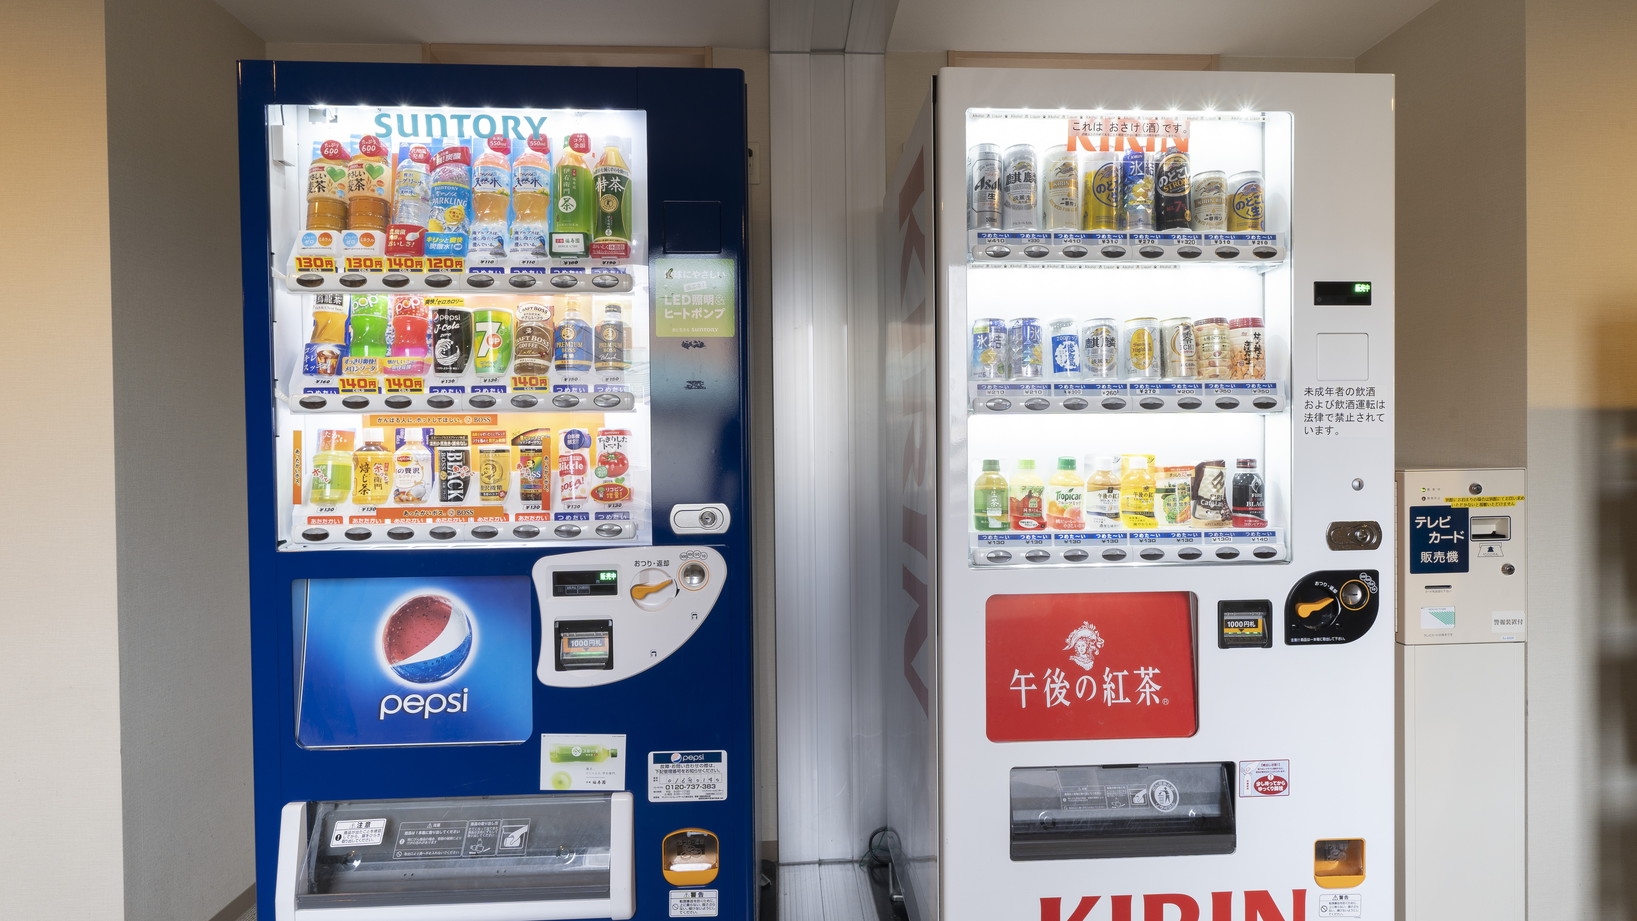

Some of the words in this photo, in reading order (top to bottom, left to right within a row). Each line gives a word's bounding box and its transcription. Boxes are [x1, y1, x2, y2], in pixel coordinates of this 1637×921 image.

[375, 112, 548, 140] SUNTORY
[1072, 122, 1102, 132] これは
[1109, 122, 1187, 133] おさけ(酒)です。
[1066, 118, 1189, 152] KIRIN
[596, 176, 625, 192] 特茶
[561, 197, 574, 211] 茶
[296, 257, 334, 268] 130円
[346, 257, 383, 268] 130円
[388, 257, 424, 268] 140円
[427, 257, 463, 268] 120円
[395, 297, 420, 315] pop
[440, 314, 460, 322] pepsi
[664, 307, 726, 319] ヒートポンプ
[476, 321, 502, 357] 7
[531, 335, 550, 346] BOSS
[340, 378, 377, 388] 140円
[386, 378, 422, 388] 140円
[512, 376, 547, 386] 140円
[1304, 386, 1376, 397] 未成年者の飲酒
[1304, 399, 1385, 410] および飲酒運転は
[1303, 412, 1384, 423] 法律で禁止されて
[1304, 425, 1340, 436] います。
[598, 435, 628, 443] すっきりした
[358, 462, 370, 495] 焙じ茶
[447, 452, 464, 500] BLACK
[990, 490, 999, 507] 生茶
[1414, 516, 1452, 529] テレビ
[1428, 531, 1464, 544] カード
[1420, 551, 1459, 563] 販売機
[600, 572, 617, 580] 販売中
[1314, 581, 1338, 594] おつり・返却
[1227, 620, 1256, 628] 1000円札
[1493, 618, 1523, 626] 警報装置付
[570, 639, 603, 647] 1000円札
[1010, 667, 1162, 709] 午後の紅茶
[378, 688, 469, 720] pepsi
[357, 821, 371, 829] 注意
